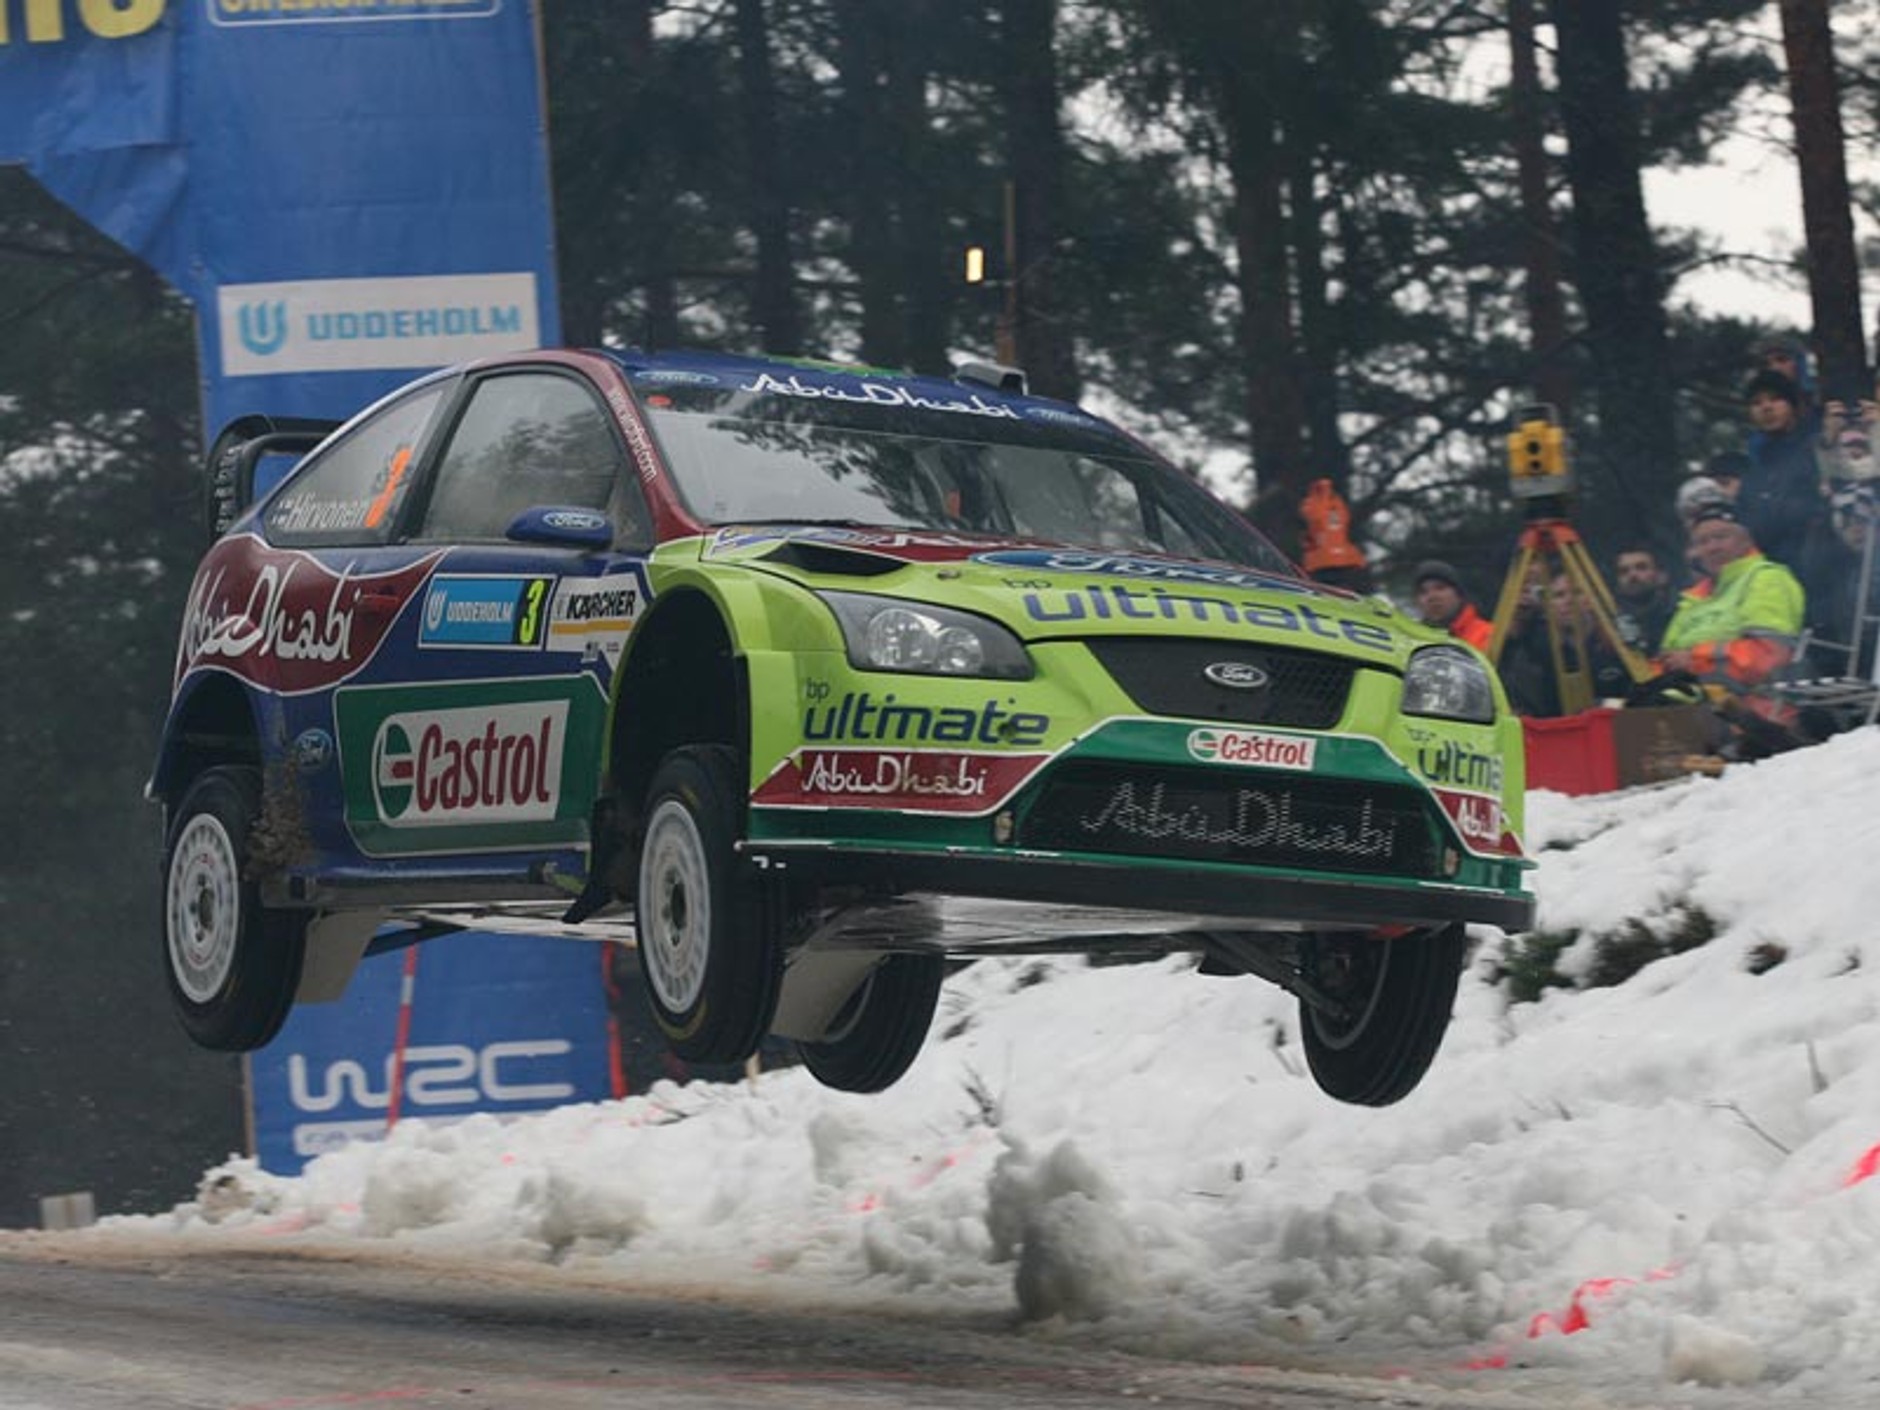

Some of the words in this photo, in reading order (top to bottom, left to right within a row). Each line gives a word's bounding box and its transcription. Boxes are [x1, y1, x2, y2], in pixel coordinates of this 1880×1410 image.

[307, 306, 520, 342] UDDEHOLM
[446, 601, 515, 623] UDDEHOLM
[519, 579, 545, 644] 3
[1025, 585, 1395, 652] ultimate
[805, 677, 830, 700] bp
[803, 692, 1050, 745] ultimate
[416, 717, 552, 812] Castrol
[1220, 733, 1309, 766] Castrol
[289, 1039, 575, 1112] WRC
